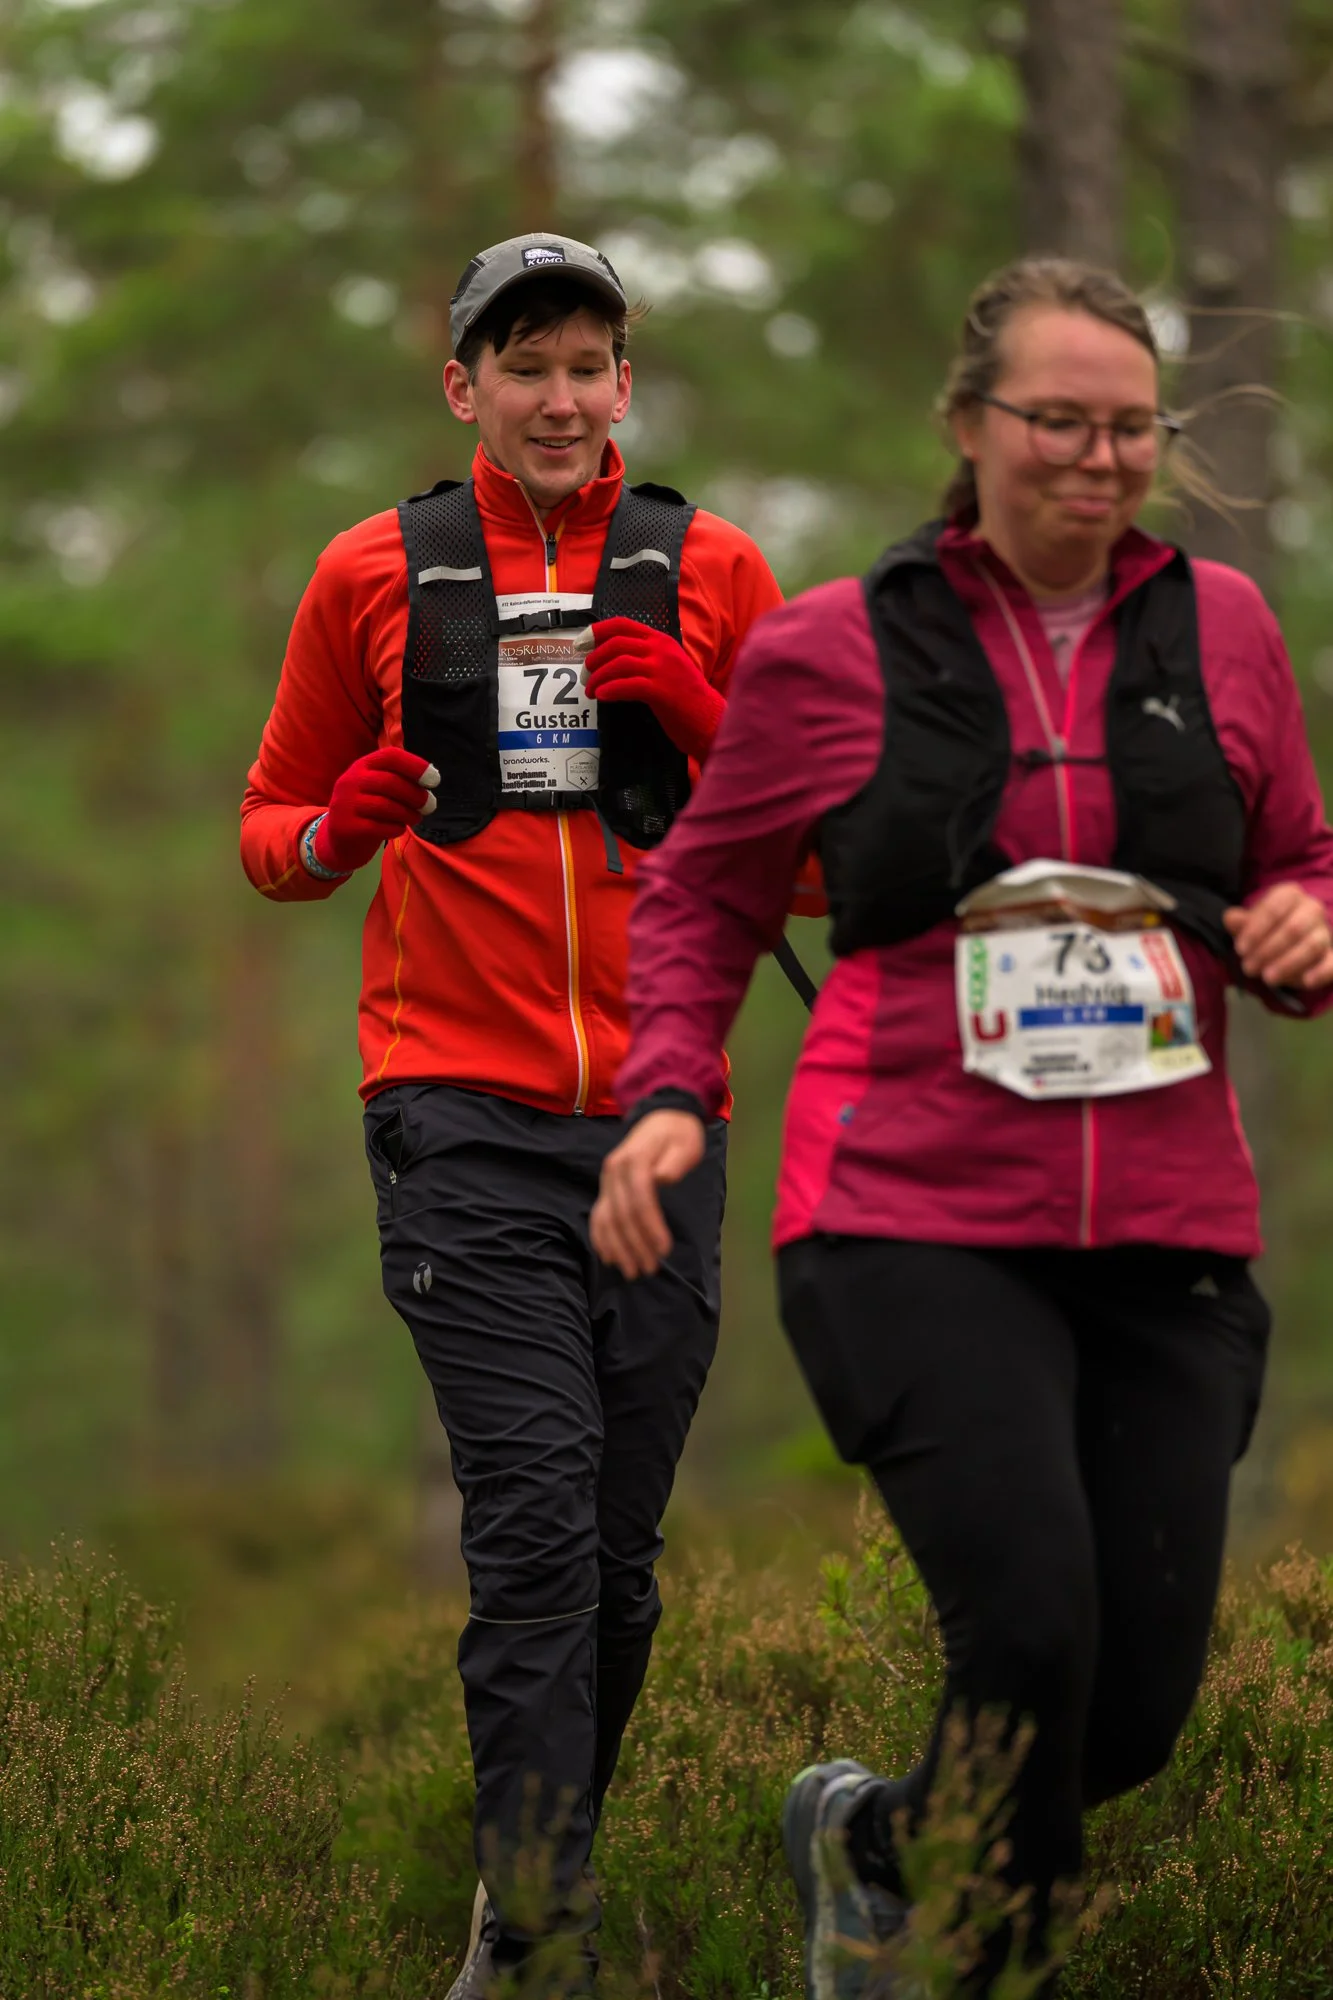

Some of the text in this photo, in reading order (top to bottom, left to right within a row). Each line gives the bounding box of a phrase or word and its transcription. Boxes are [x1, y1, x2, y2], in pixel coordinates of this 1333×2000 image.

[528, 258, 563, 266] KUMO
[523, 667, 579, 706] 72
[515, 709, 590, 729] Gustaf
[536, 733, 542, 744] 6
[503, 756, 550, 765] brandworks.
[507, 771, 548, 780] Borghamns
[1049, 932, 1112, 976] 73
